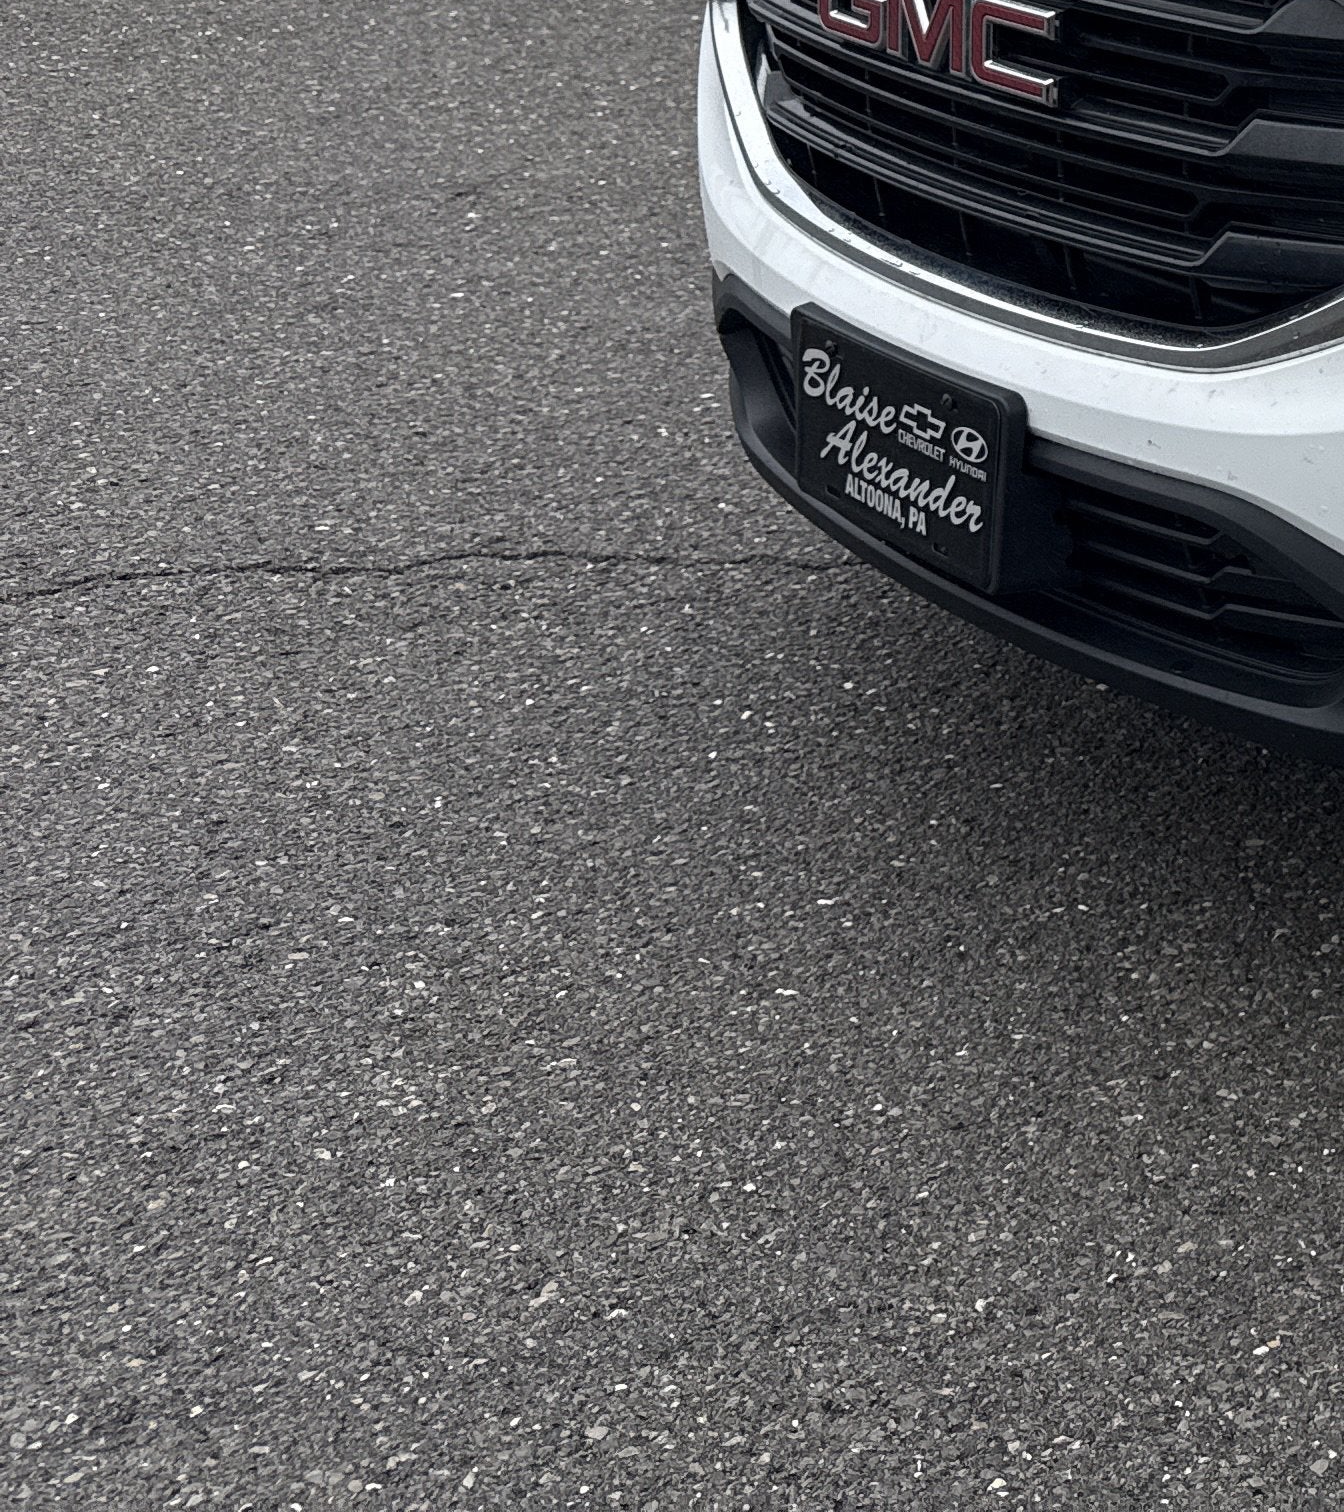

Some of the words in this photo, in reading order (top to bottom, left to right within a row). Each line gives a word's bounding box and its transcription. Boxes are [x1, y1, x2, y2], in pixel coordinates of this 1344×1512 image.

[802, 348, 897, 434] Blaise
[820, 420, 984, 533] Alexander
[898, 429, 946, 462] CHEVROLET
[949, 455, 988, 483] HYUNDAI
[845, 473, 905, 529] ALTOONA,
[908, 505, 928, 537] PA
